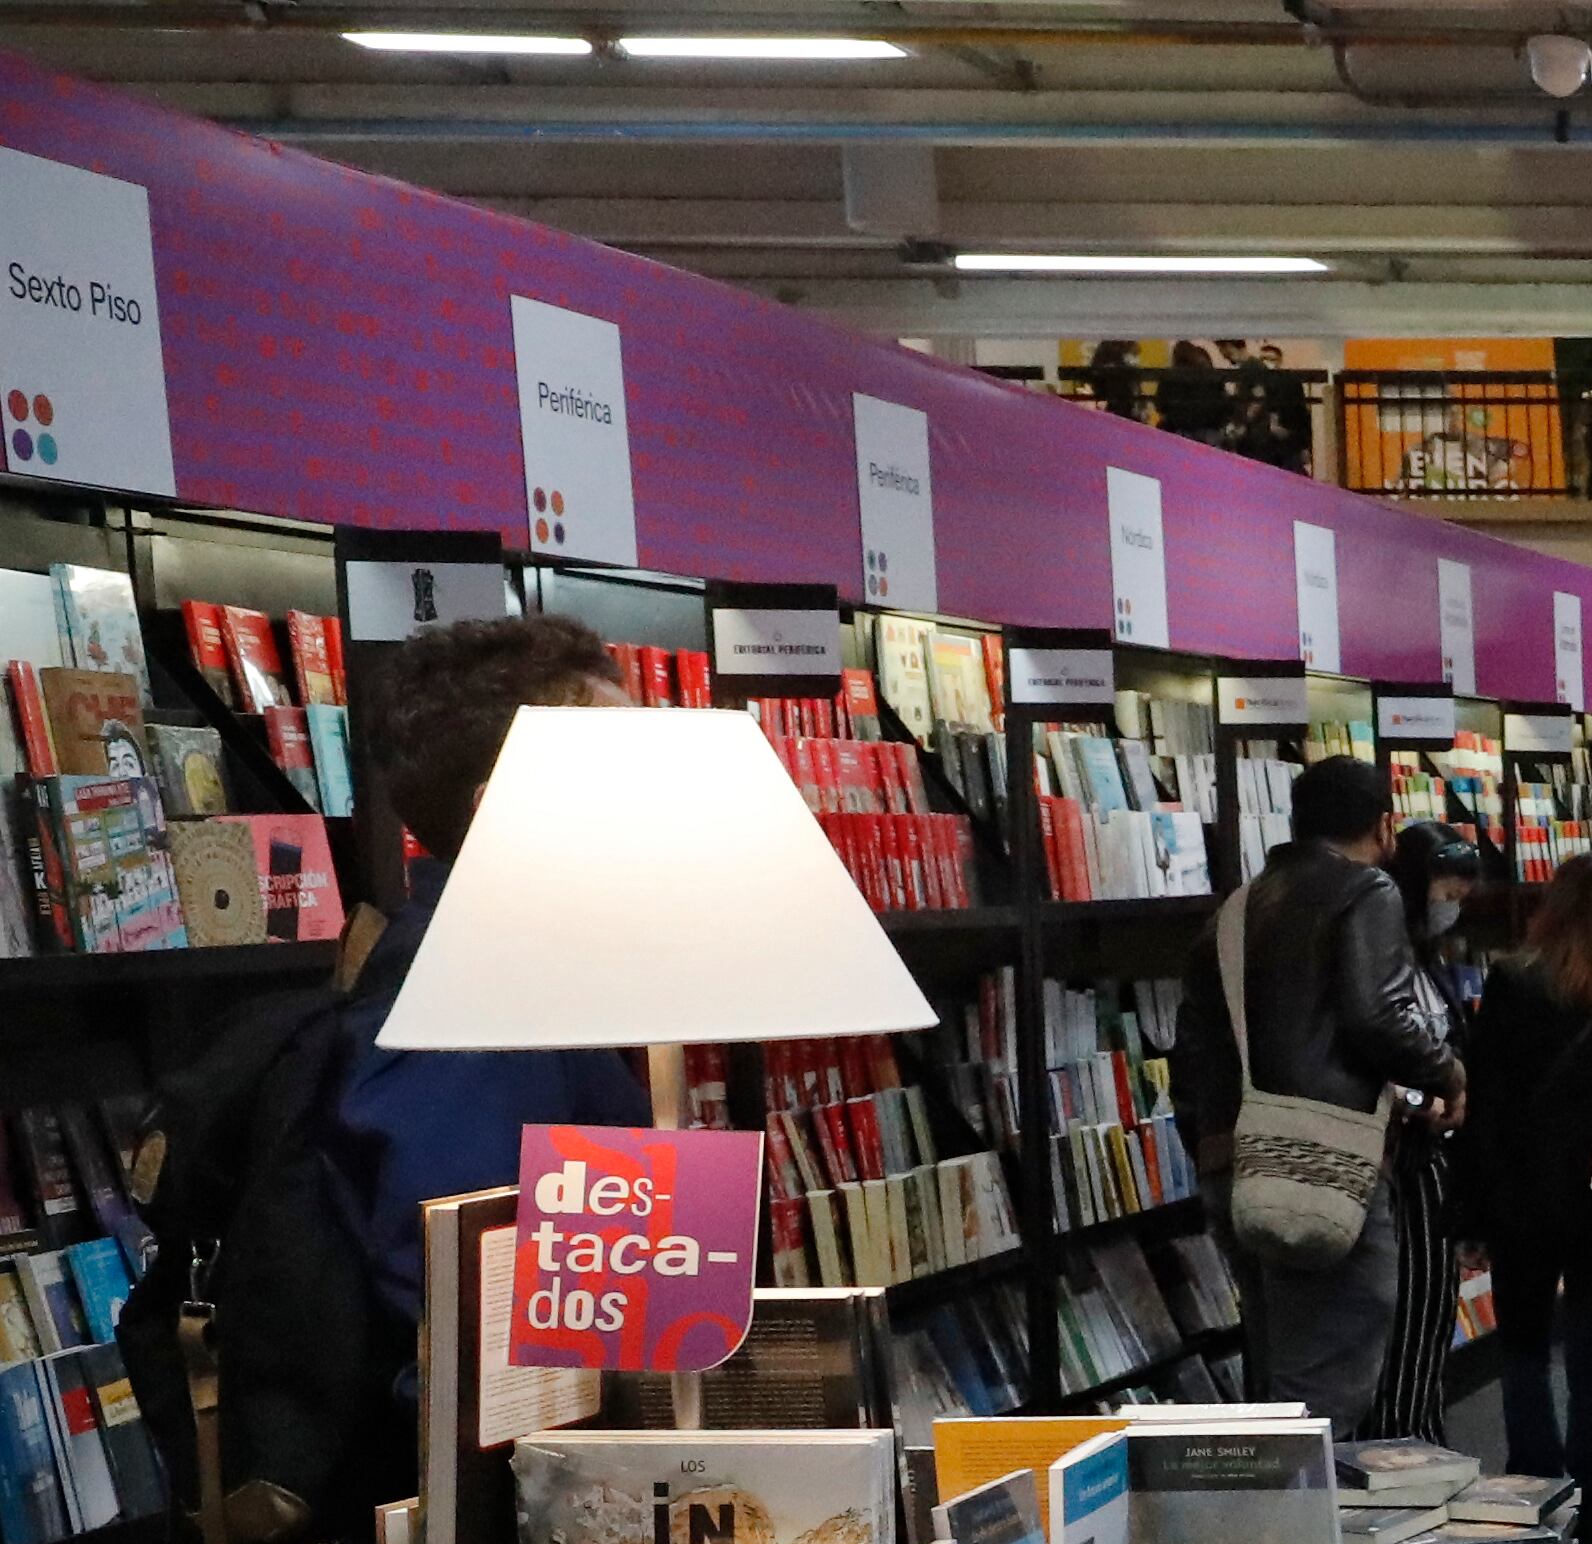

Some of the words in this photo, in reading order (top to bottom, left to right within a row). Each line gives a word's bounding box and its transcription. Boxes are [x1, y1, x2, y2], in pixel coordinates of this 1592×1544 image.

[8, 260, 82, 311] Sexto
[90, 281, 142, 326] Piso
[537, 381, 613, 426] Periférica
[869, 462, 920, 496] Periférica
[534, 1160, 671, 1216] des-
[531, 1221, 738, 1277] taca-
[528, 1289, 627, 1331] dos
[680, 1461, 705, 1473] LOS
[1185, 1447, 1212, 1457] JANE
[1217, 1446, 1256, 1457] SMILEY
